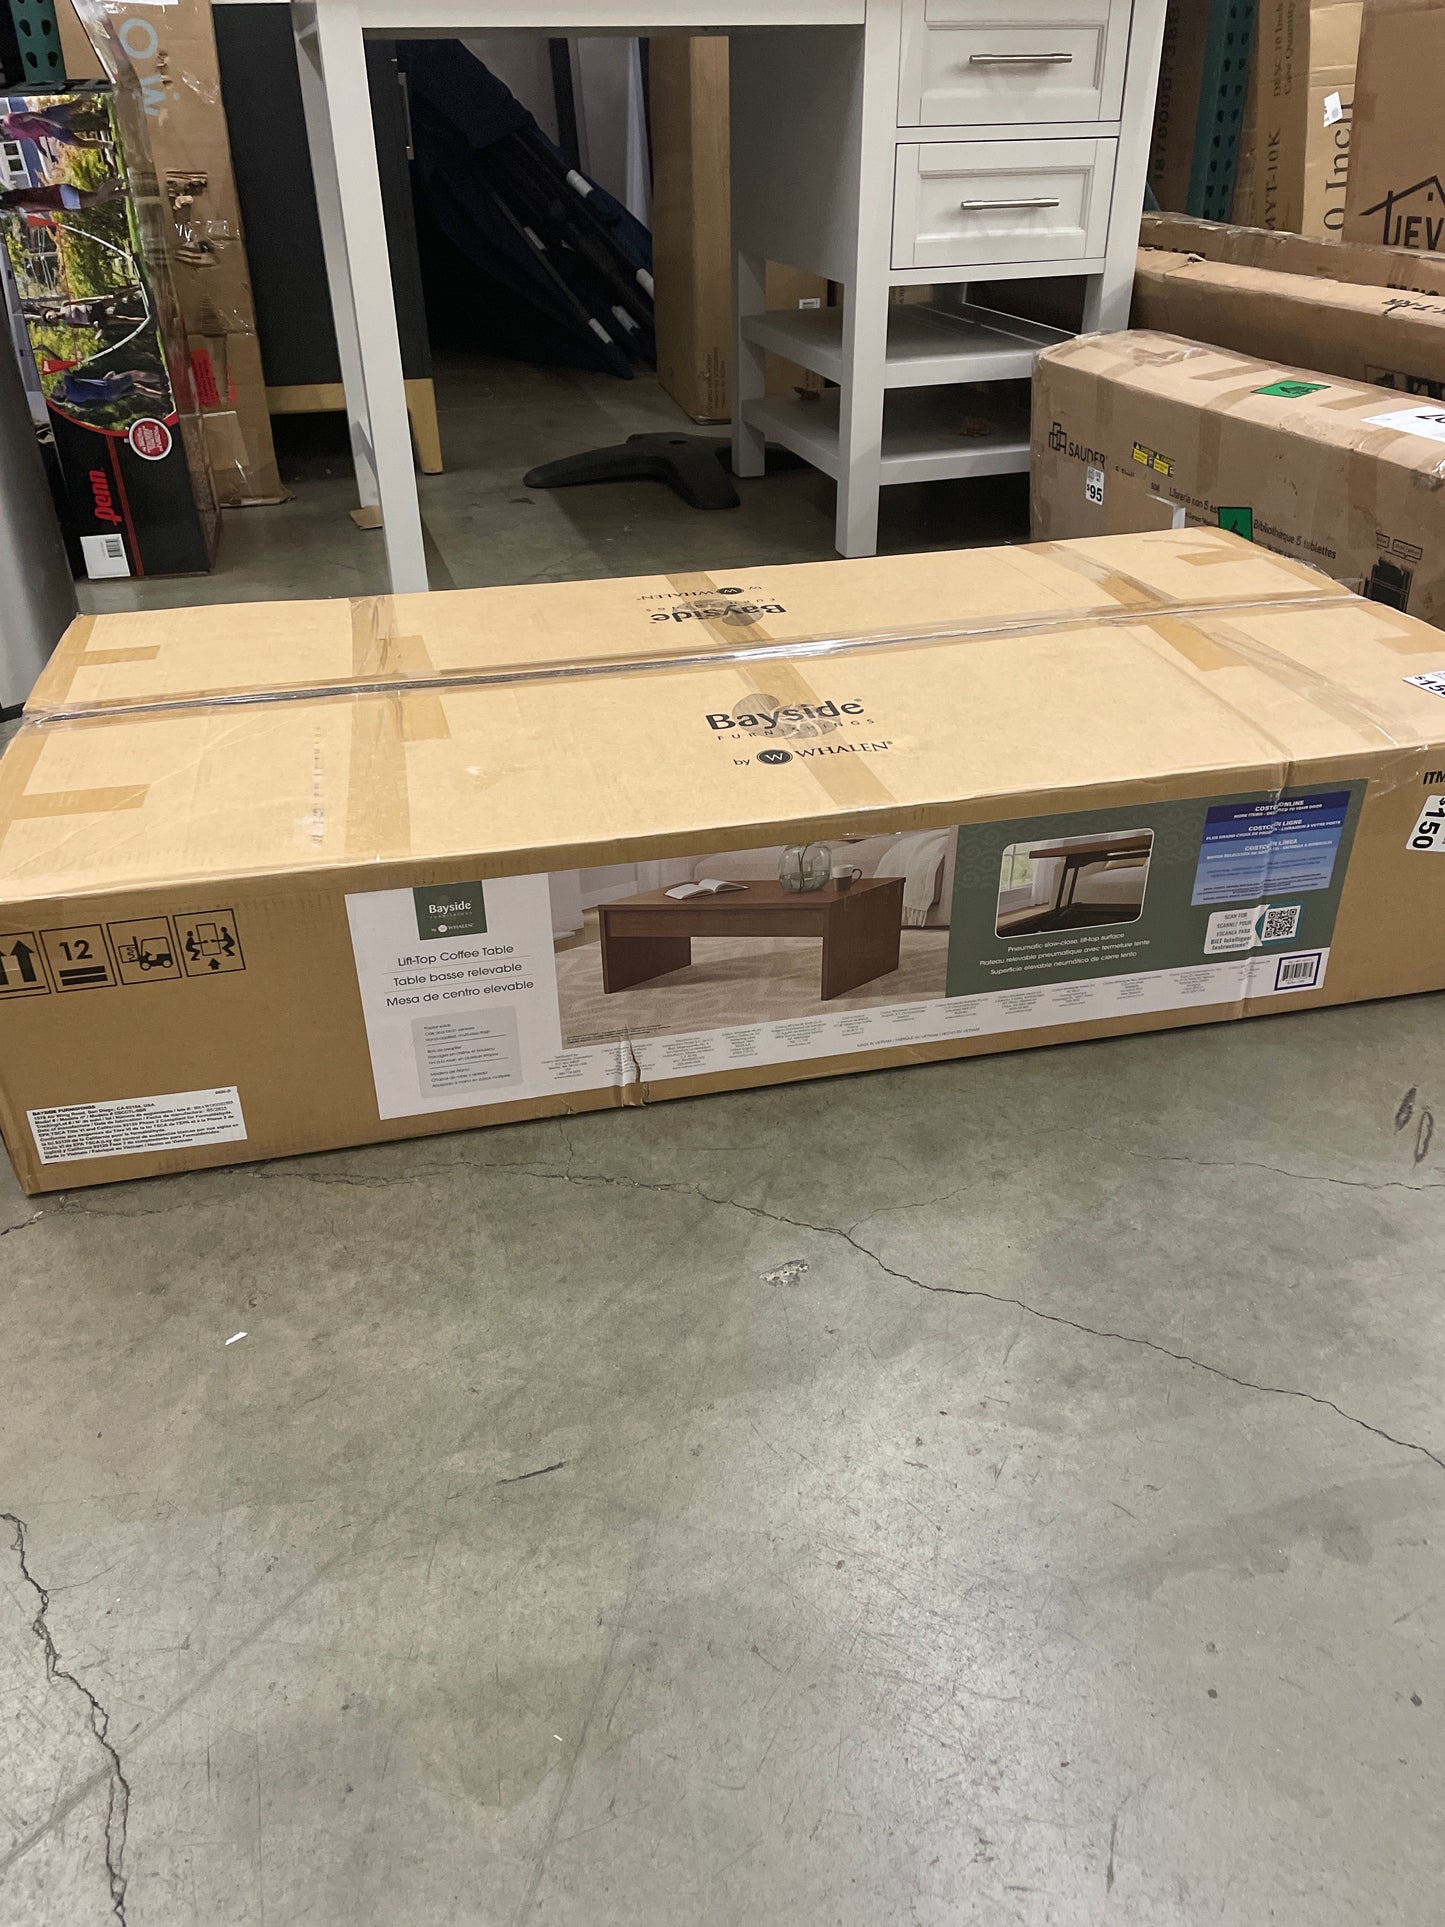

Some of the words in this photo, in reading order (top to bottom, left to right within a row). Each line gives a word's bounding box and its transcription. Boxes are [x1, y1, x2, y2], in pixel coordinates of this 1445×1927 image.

[89, 470, 122, 526] penn
[1086, 484, 1103, 502] $95
[1296, 535, 1302, 546] 5
[1303, 537, 1336, 560] tablettes
[650, 604, 787, 623] Bayside
[705, 700, 865, 730] Bayside
[734, 758, 750, 767] by
[1282, 819, 1303, 827] LIGNE
[429, 901, 472, 914] Bayside
[59, 939, 93, 961] 12
[979, 957, 1005, 966] Plateau
[1006, 953, 1038, 963] relevable
[1038, 947, 1083, 960] pneumatique
[1101, 941, 1134, 951] fermeture
[1134, 938, 1151, 946] lente
[1007, 943, 1044, 952] Pneumatic
[1100, 932, 1126, 941] surface
[398, 955, 437, 967] Lift-Top
[440, 949, 479, 961] Coffee
[482, 945, 514, 956] Table
[990, 965, 1023, 975] Superficie
[1023, 962, 1053, 972] elevable
[1101, 953, 1120, 961] cierre
[1120, 951, 1138, 959] lento
[393, 975, 426, 987] Table
[430, 971, 465, 982] basse
[468, 963, 522, 977] relevable
[387, 996, 420, 1007] Mesa
[423, 992, 439, 1002] de
[443, 986, 480, 999] centro
[484, 980, 534, 994] elevable
